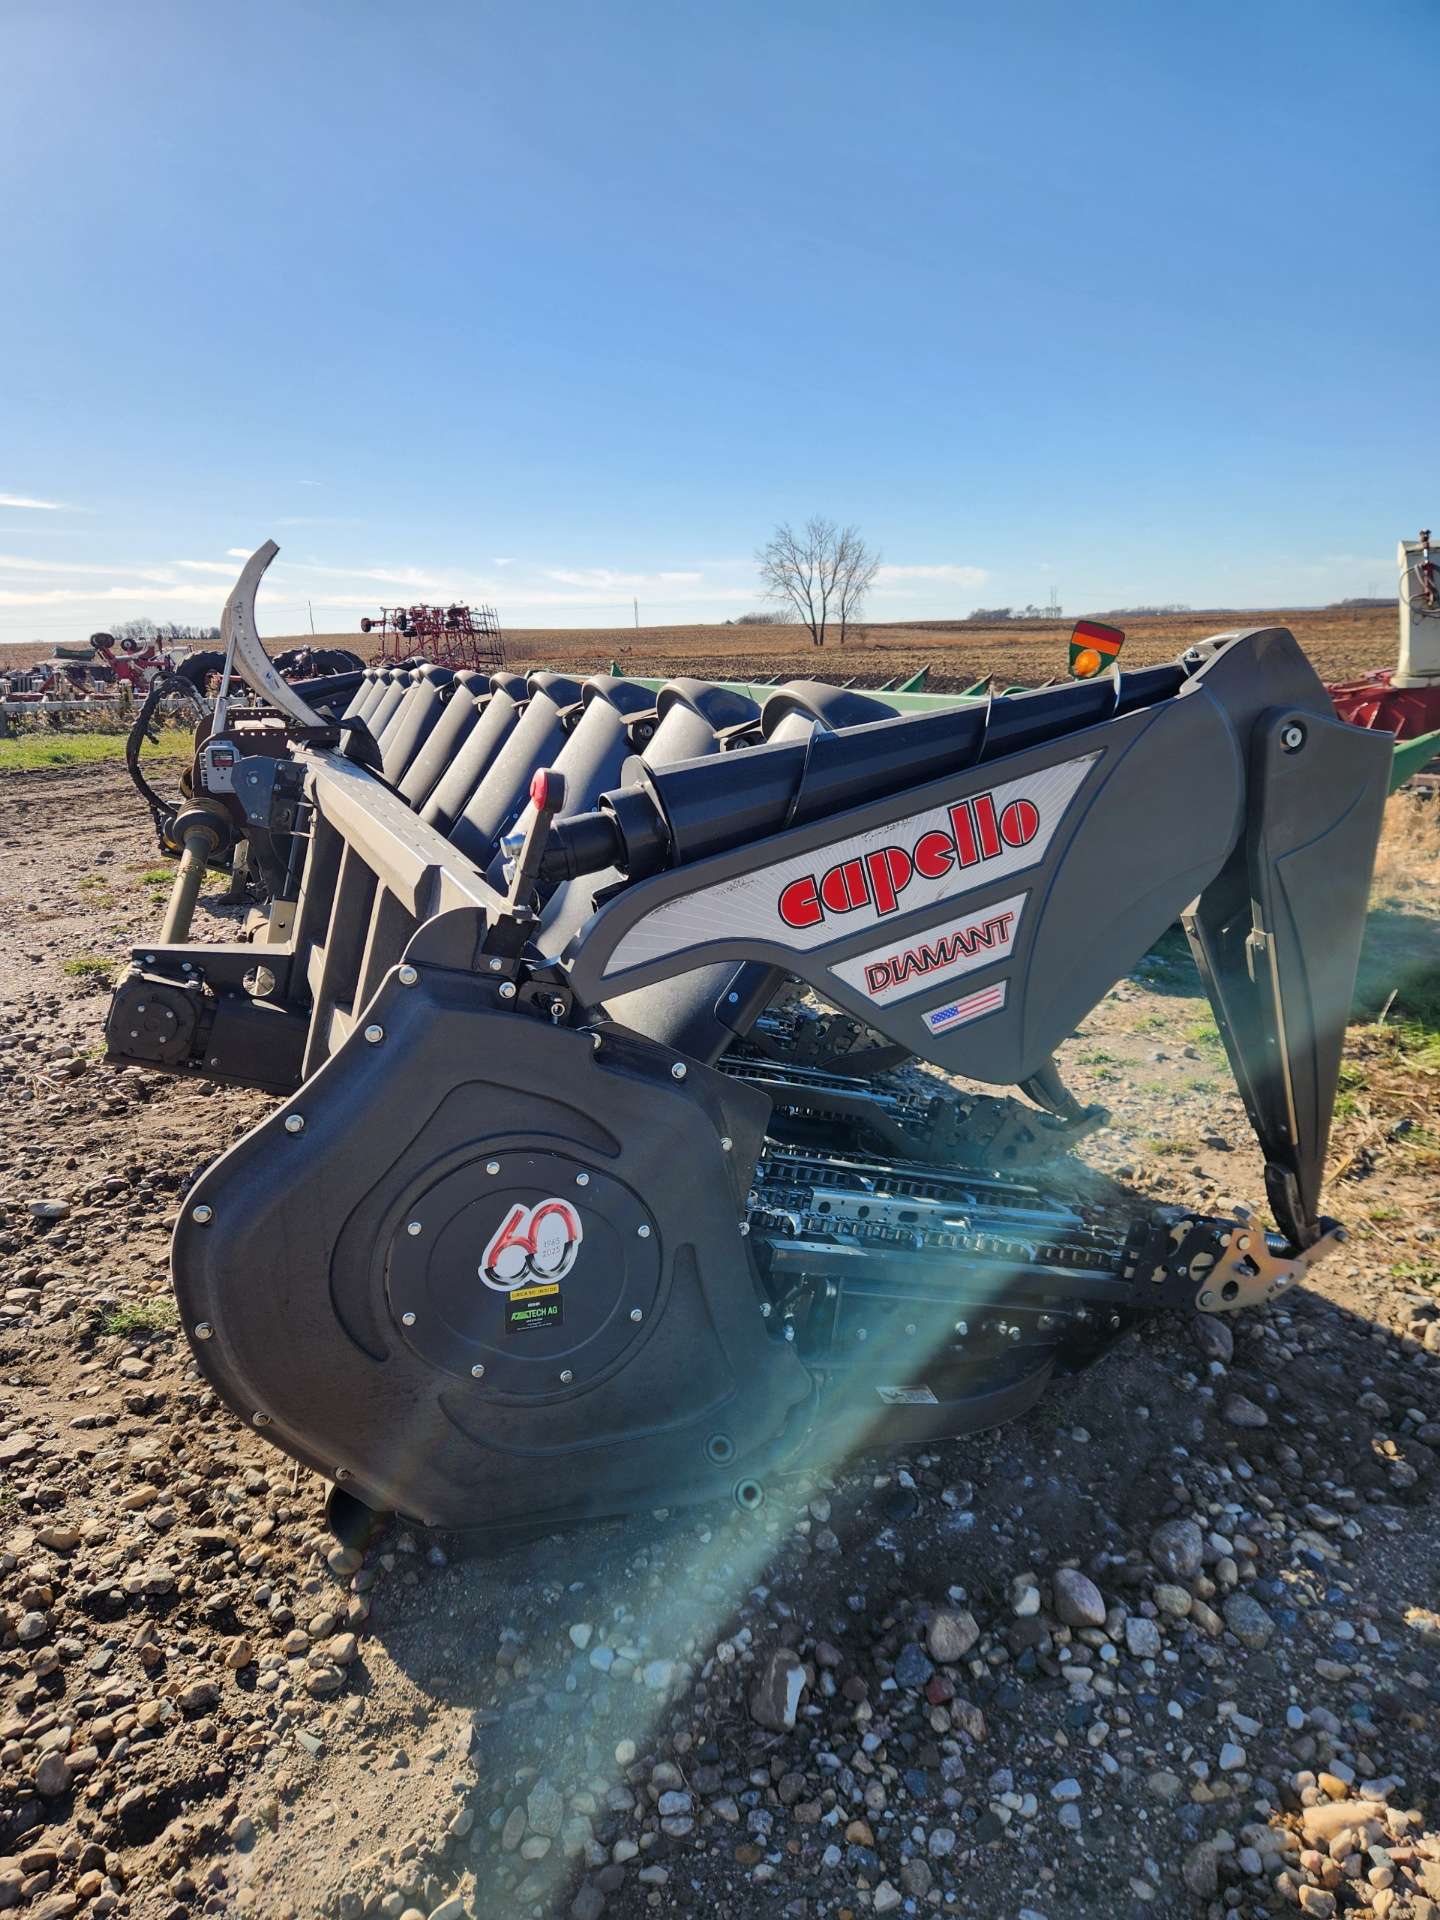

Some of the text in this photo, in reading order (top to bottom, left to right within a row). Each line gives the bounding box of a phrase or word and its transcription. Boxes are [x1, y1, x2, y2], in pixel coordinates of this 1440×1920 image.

[777, 791, 1040, 930] capello
[864, 912, 1014, 995] DIAMANT
[483, 1202, 578, 1287] 60
